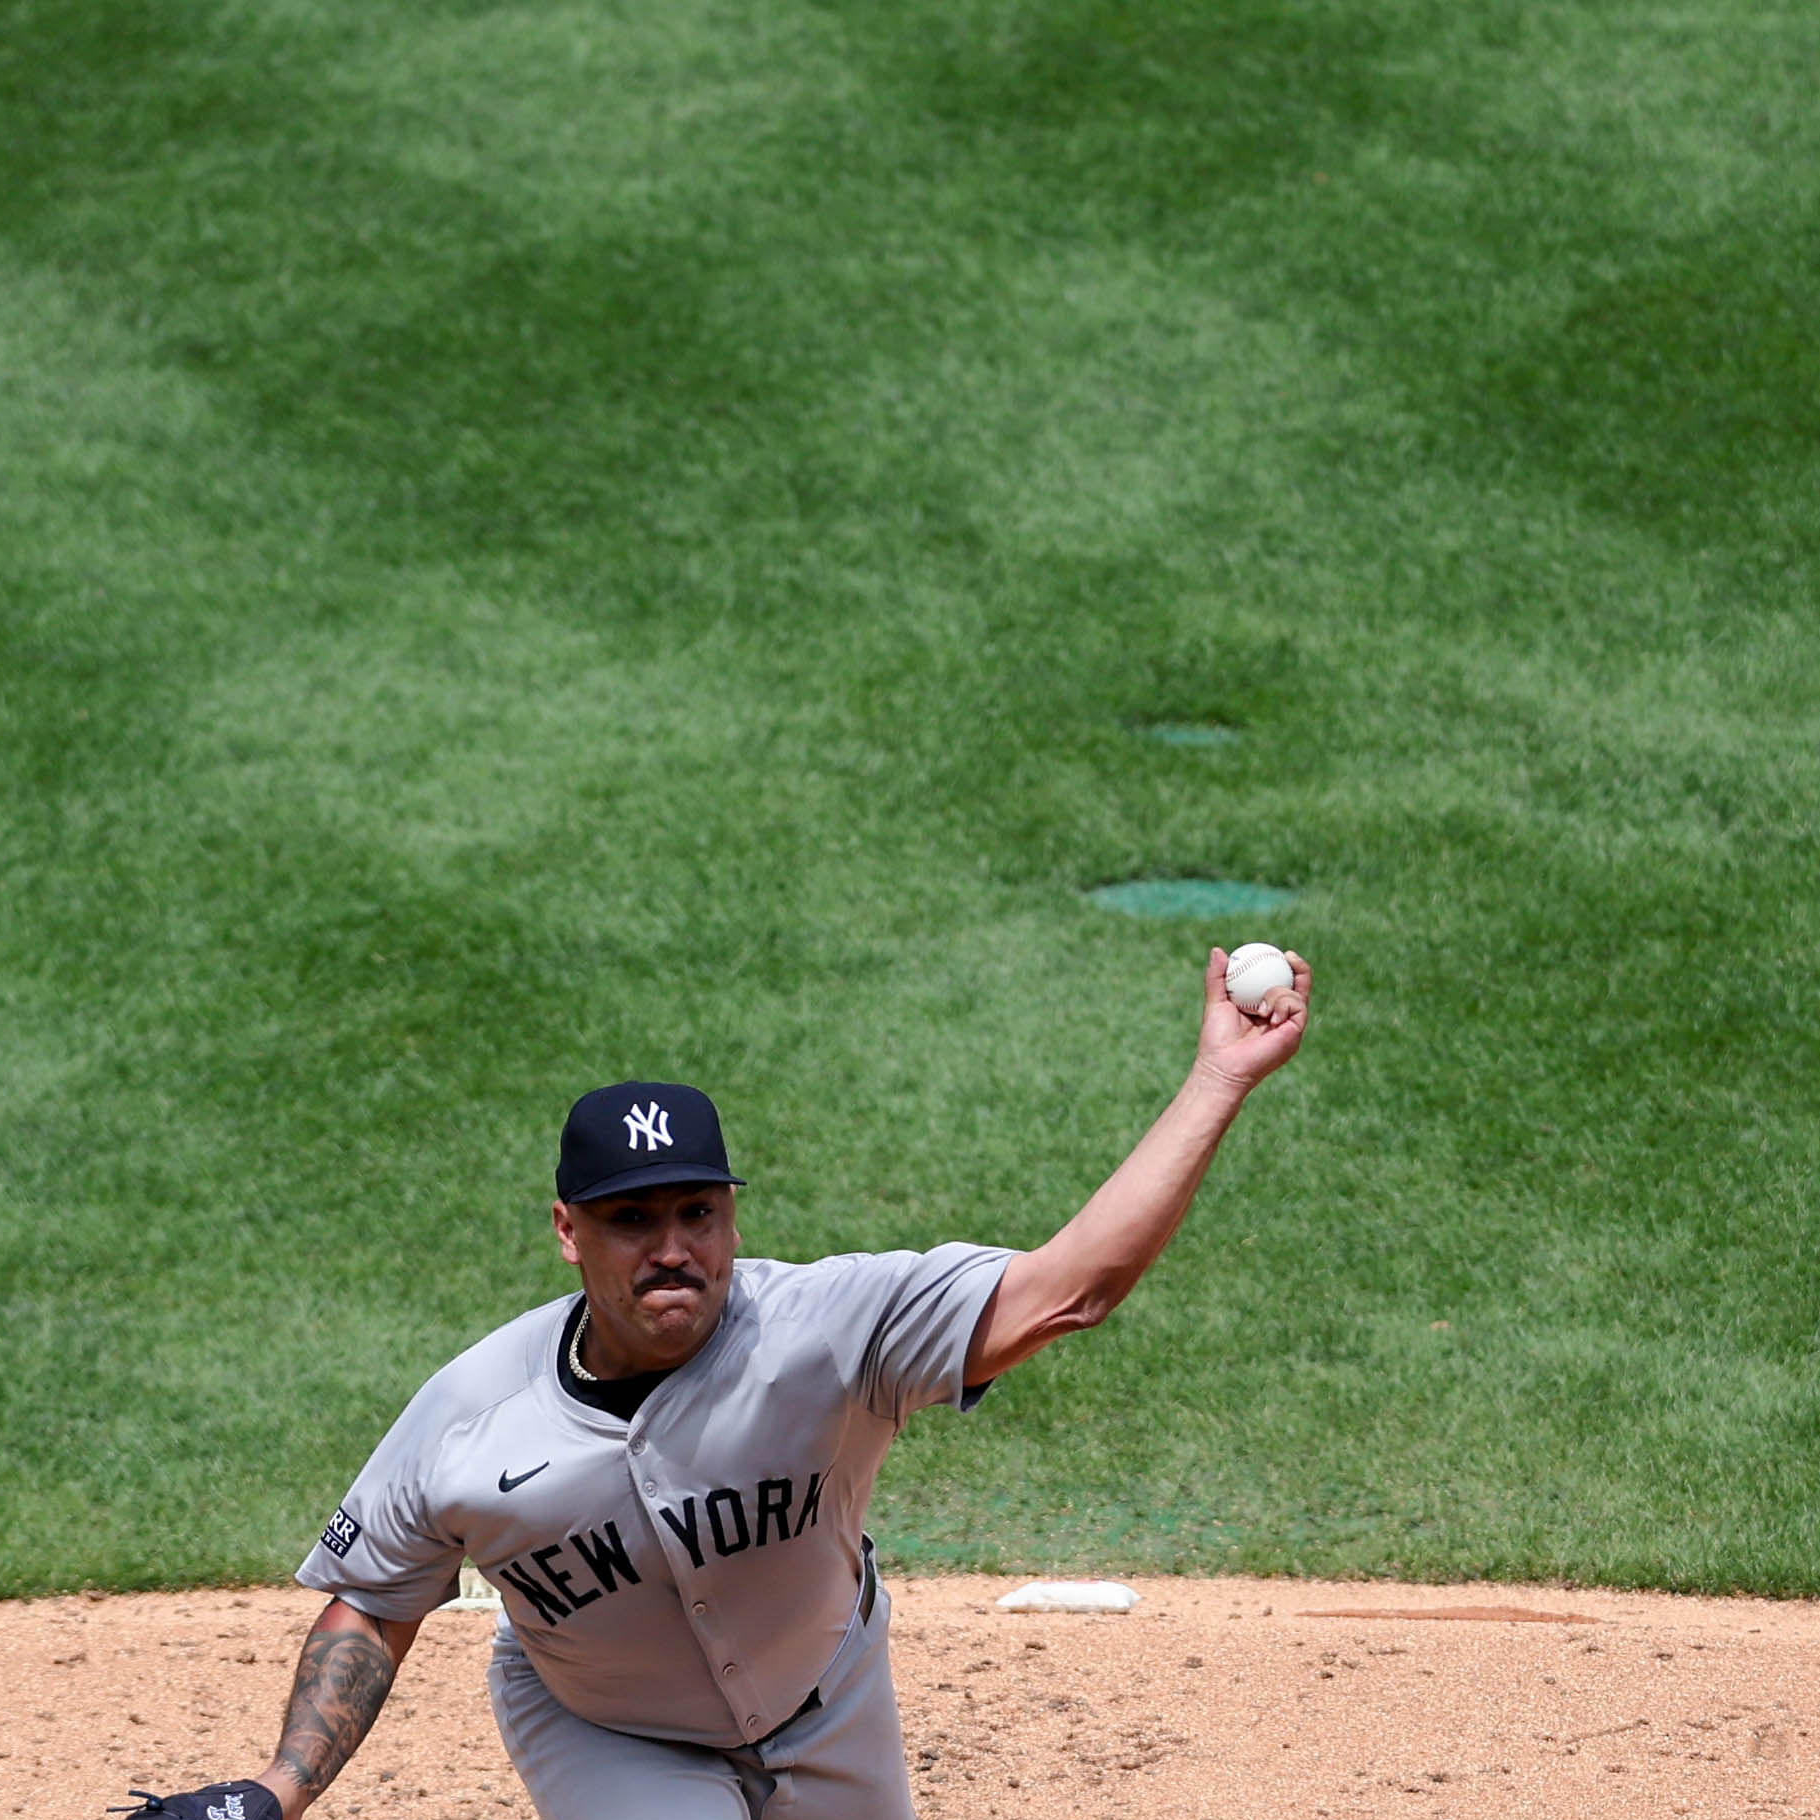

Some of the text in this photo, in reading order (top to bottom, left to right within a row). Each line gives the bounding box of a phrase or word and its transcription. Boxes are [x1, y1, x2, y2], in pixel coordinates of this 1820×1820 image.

[622, 1101, 674, 1151] NY
[499, 1462, 834, 1627] NEW YORK
